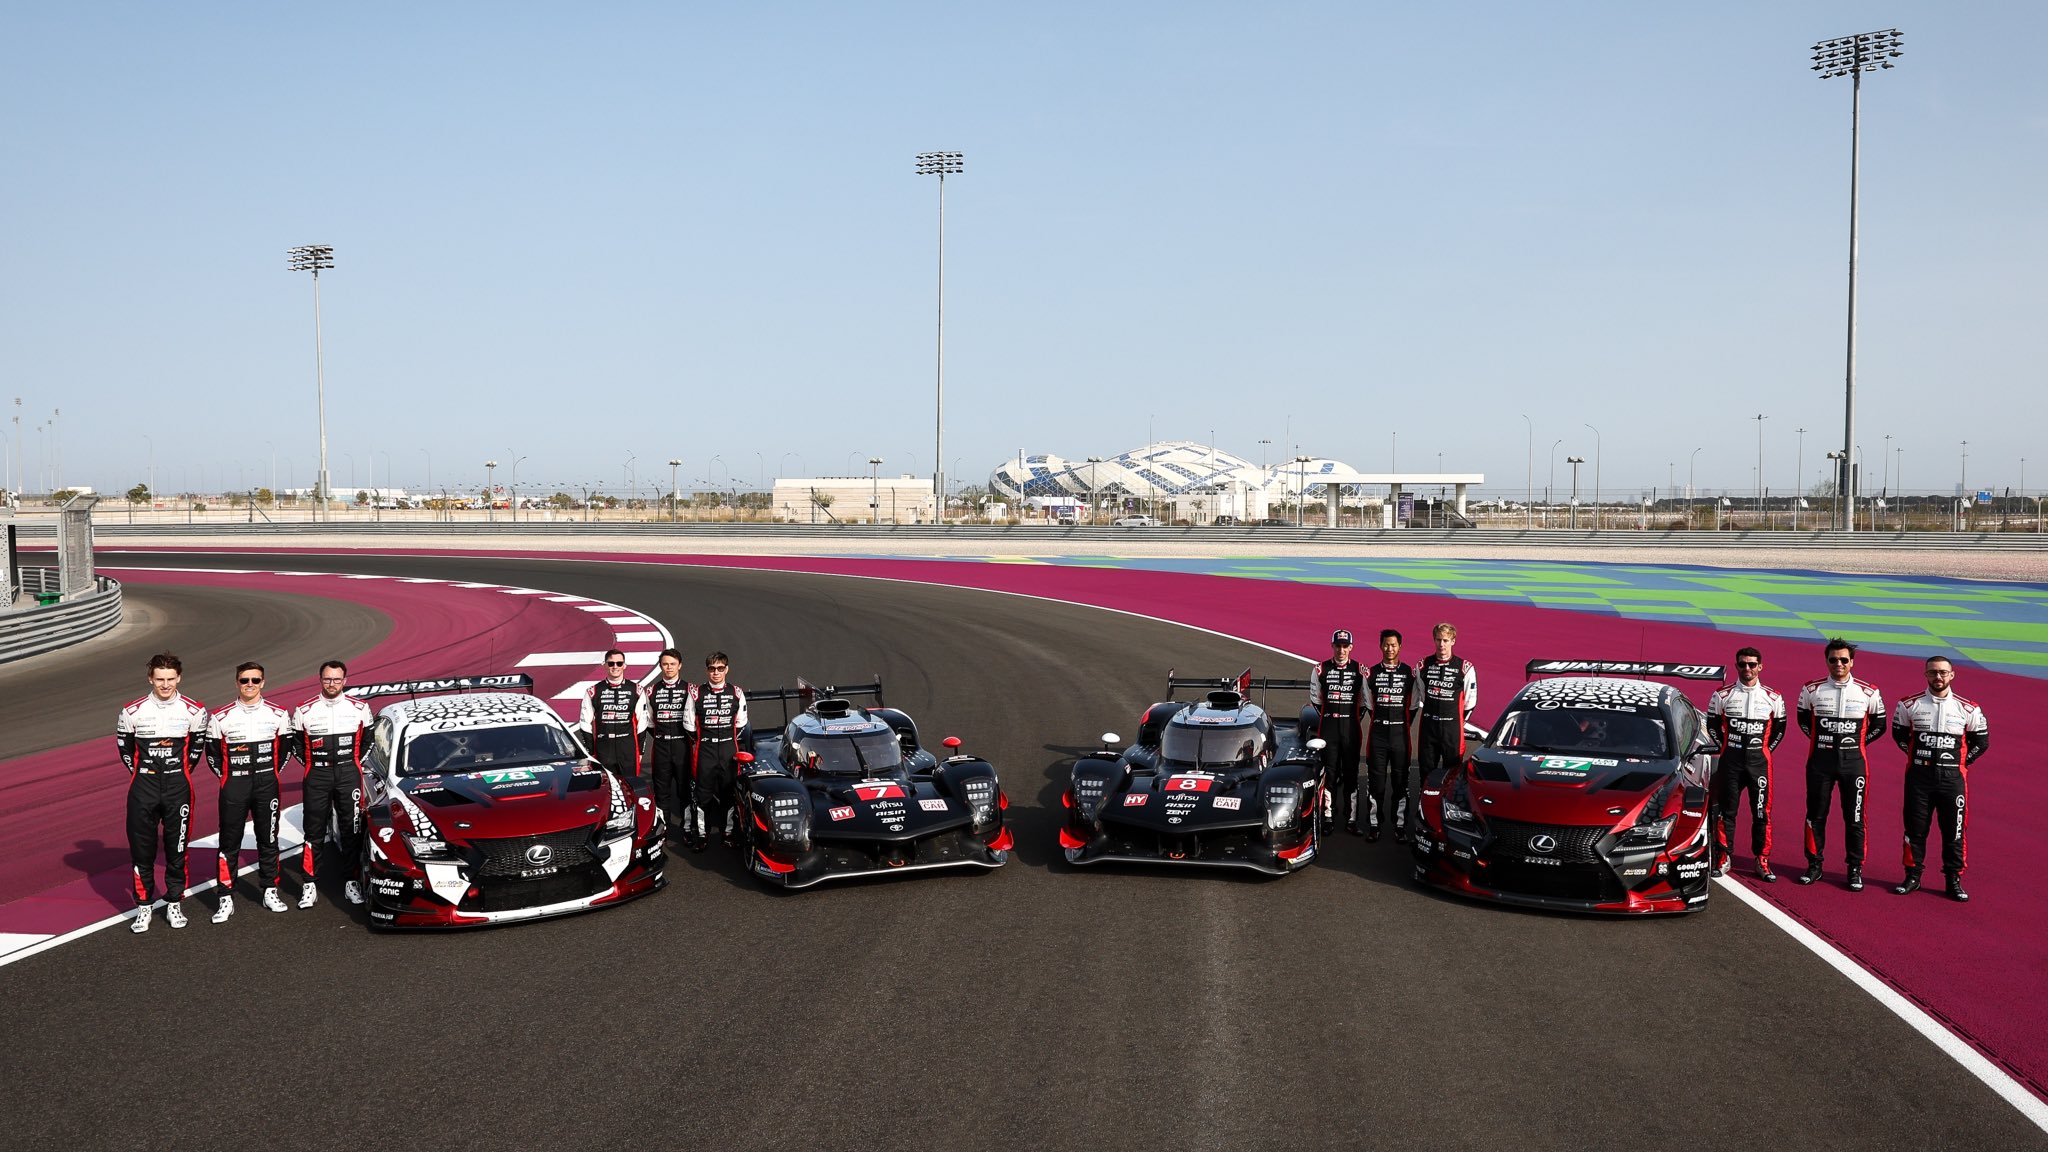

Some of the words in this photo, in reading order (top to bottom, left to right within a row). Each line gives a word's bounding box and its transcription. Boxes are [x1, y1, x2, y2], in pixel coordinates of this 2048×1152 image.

[1537, 661, 1665, 672] MINERVA
[1678, 665, 1714, 674] OIL
[346, 678, 472, 697] MINERVA
[485, 676, 518, 685] OIL
[1428, 679, 1454, 688] DENSO
[1562, 702, 1637, 713] LEXUS
[459, 717, 533, 727] LEXUS
[1545, 759, 1589, 769] 87
[486, 771, 530, 783] 78
[1179, 779, 1197, 789] 8
[870, 786, 888, 798] 7
[1166, 793, 1199, 801] FUJITSU
[1126, 795, 1146, 804] HY
[870, 801, 904, 810] FUJITSU
[1854, 790, 1862, 822] LEXUS
[353, 801, 361, 835] LEXUS
[831, 808, 851, 819] HY
[875, 809, 906, 817] AISIN
[881, 816, 906, 824] ZENT
[269, 810, 277, 844] LEXUS
[177, 817, 187, 853] LEXUS
[1680, 870, 1700, 879] SONIC
[370, 878, 405, 888] GOODYEAR
[379, 887, 400, 896] SONIC
